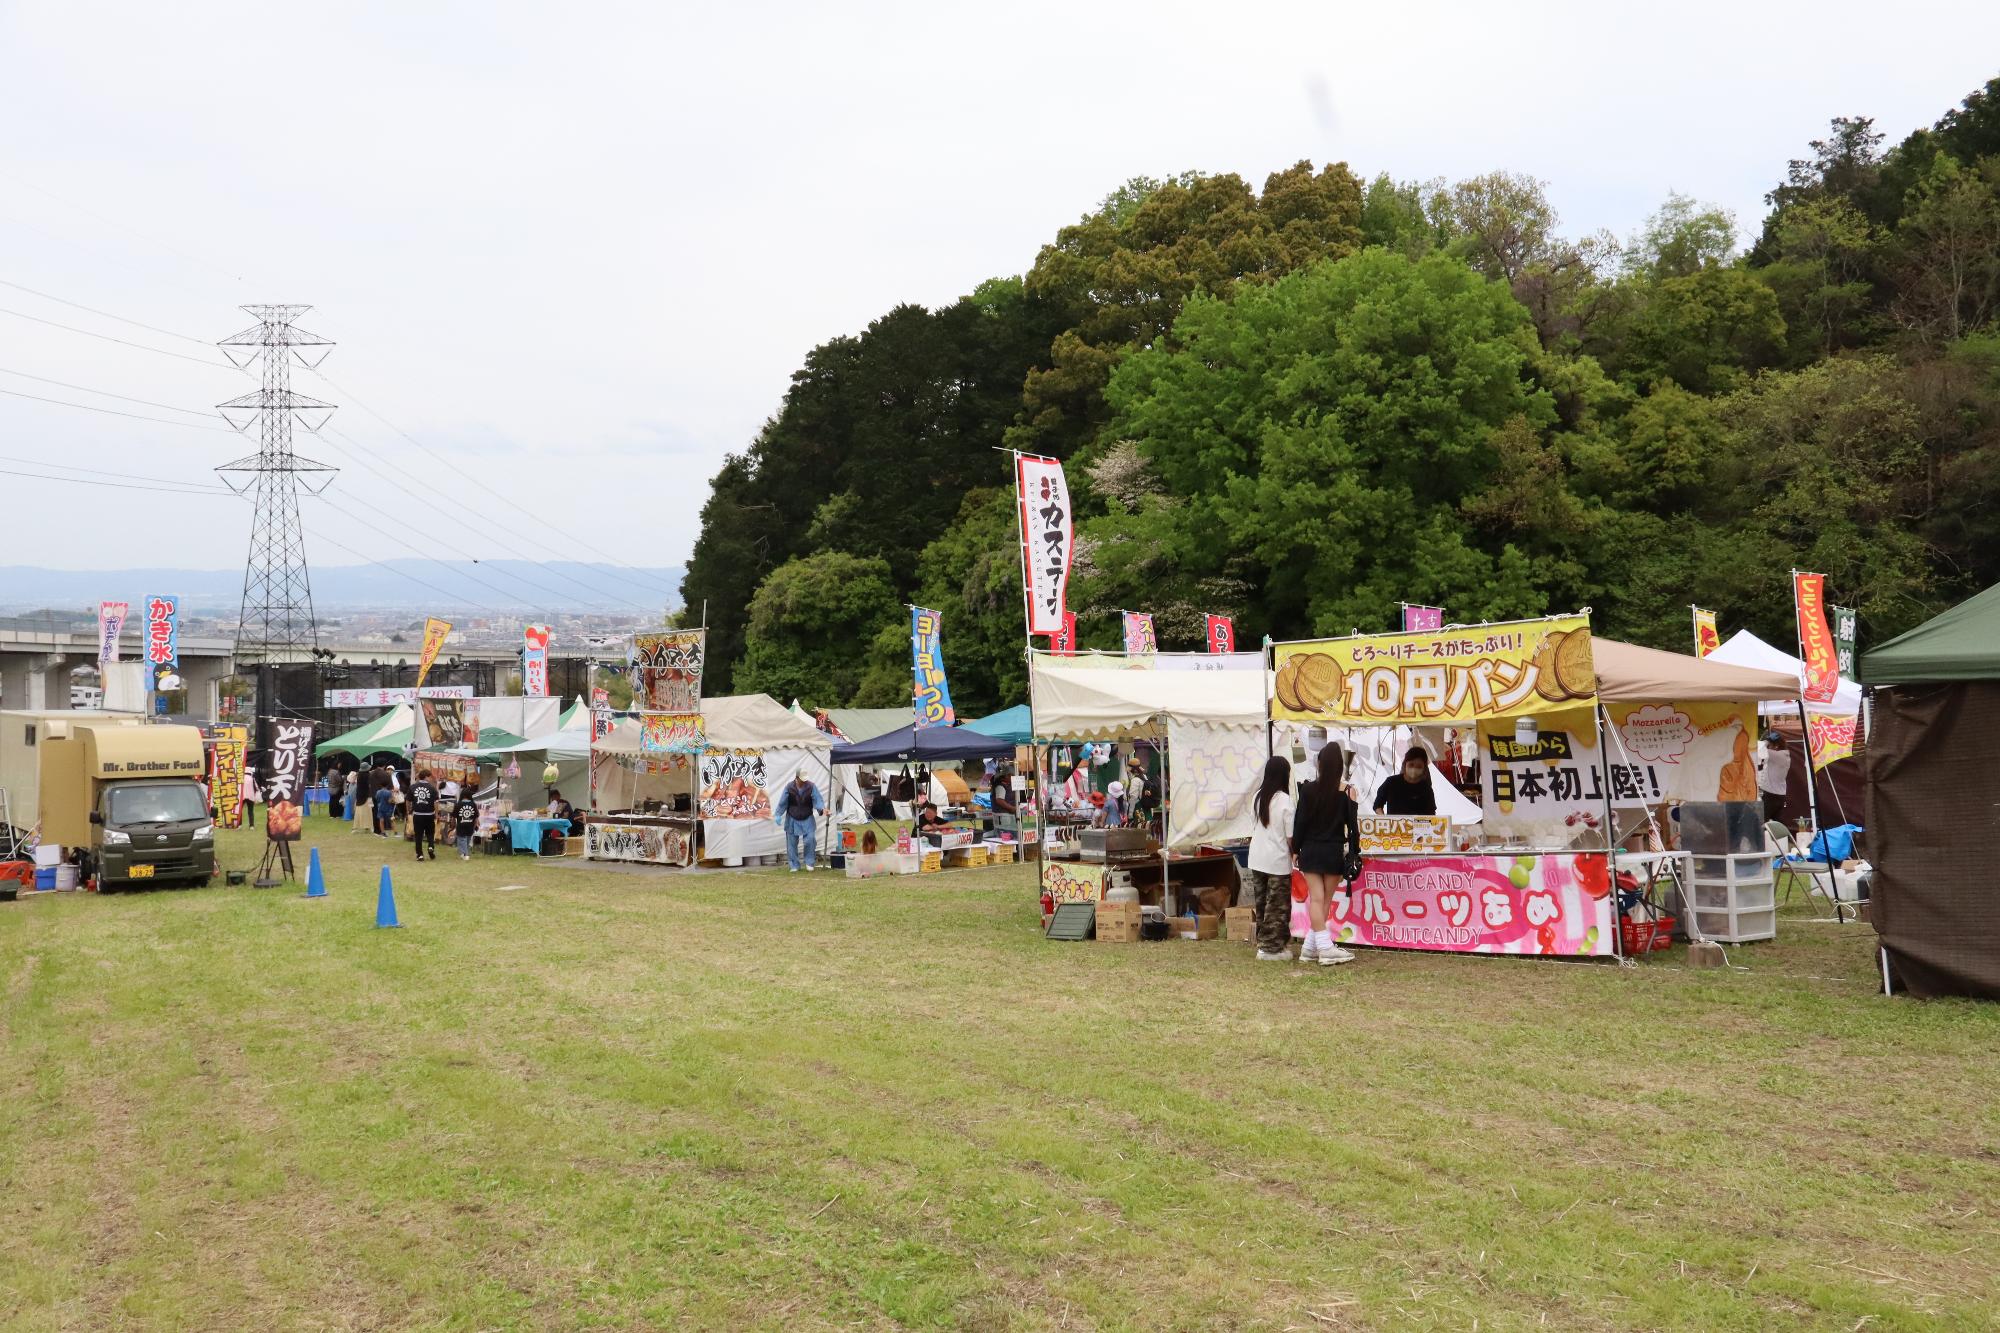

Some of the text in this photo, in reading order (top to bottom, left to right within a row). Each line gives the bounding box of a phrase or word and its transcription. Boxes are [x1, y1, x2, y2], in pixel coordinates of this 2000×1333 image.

[149, 598, 174, 663] かき氷
[529, 660, 542, 695] 削りいち
[917, 615, 946, 722] ヨーヨーつり
[338, 691, 368, 705] 芝桜
[1343, 658, 1540, 717] 10円パン
[1632, 716, 1681, 727] Mozzarella
[266, 725, 300, 800] とり天
[1492, 737, 1567, 759] 韓国から
[103, 763, 124, 773] Mr.
[214, 727, 239, 825] フライドポテト
[702, 754, 768, 788] いかやき
[1364, 871, 1475, 890] FRUITCANDY
[1373, 924, 1484, 945] FRUITCANDY
